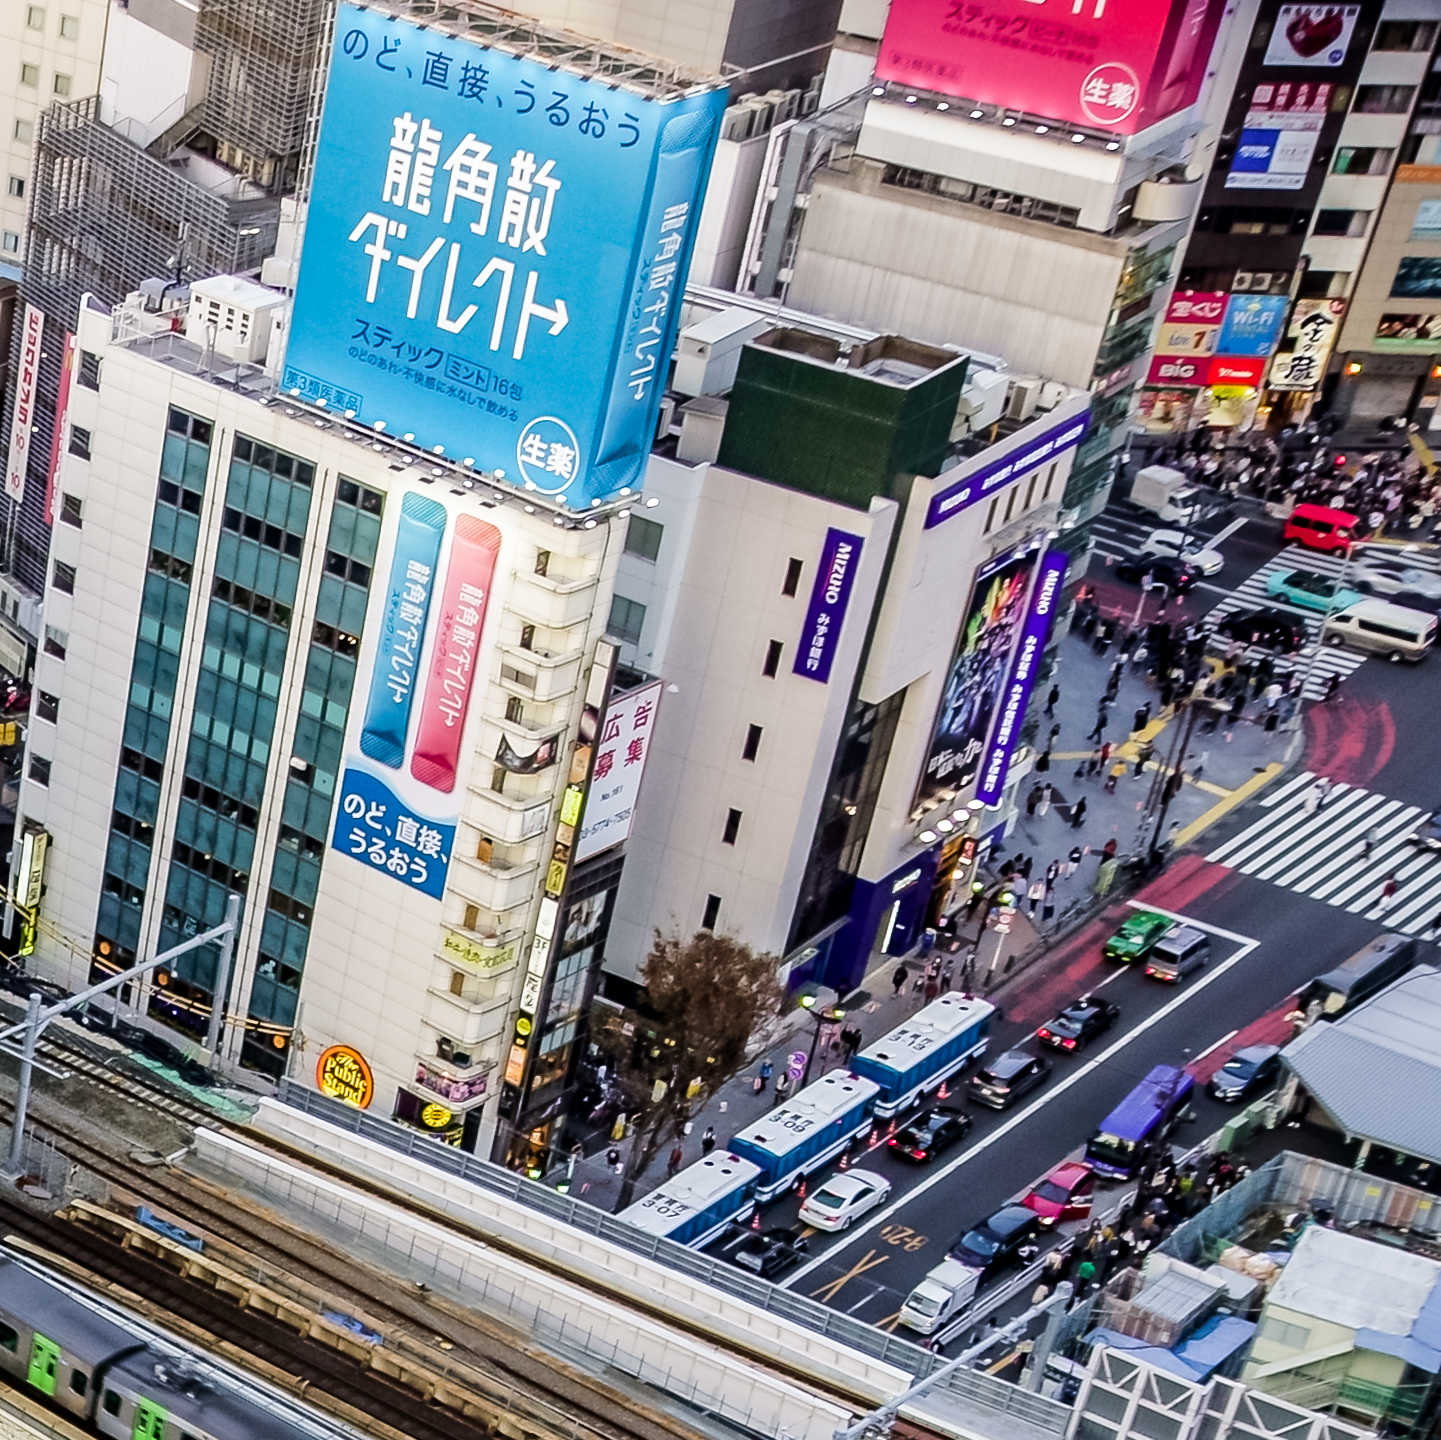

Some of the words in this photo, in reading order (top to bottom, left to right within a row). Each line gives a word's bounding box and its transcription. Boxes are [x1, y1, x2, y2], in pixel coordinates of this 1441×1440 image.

[343, 28, 641, 148] のど、直接、うるおう
[1085, 77, 1136, 111] 生薬
[381, 111, 563, 257] 龍角散
[349, 211, 570, 361] ダイレクト
[1170, 301, 1223, 318] 宝くじ
[1232, 310, 1275, 326] Wi-Fi
[352, 318, 444, 369] スティック
[447, 356, 489, 388] ミント
[492, 375, 523, 402] 16包
[1158, 363, 1196, 379] BIG
[520, 432, 576, 480] 生薬
[825, 542, 853, 605] MIZUHO
[1036, 569, 1060, 616] MIZUHO
[387, 559, 431, 704] 龍角散ダイレクト
[439, 582, 484, 727] 龍角散ダイレクト
[343, 793, 449, 863] のど、直接、
[350, 829, 429, 884] うるおう
[324, 1072, 362, 1104] Stand
[325, 1057, 368, 1092] Public
[769, 1113, 807, 1134] 3-09
[641, 1199, 681, 1220] 3-07
